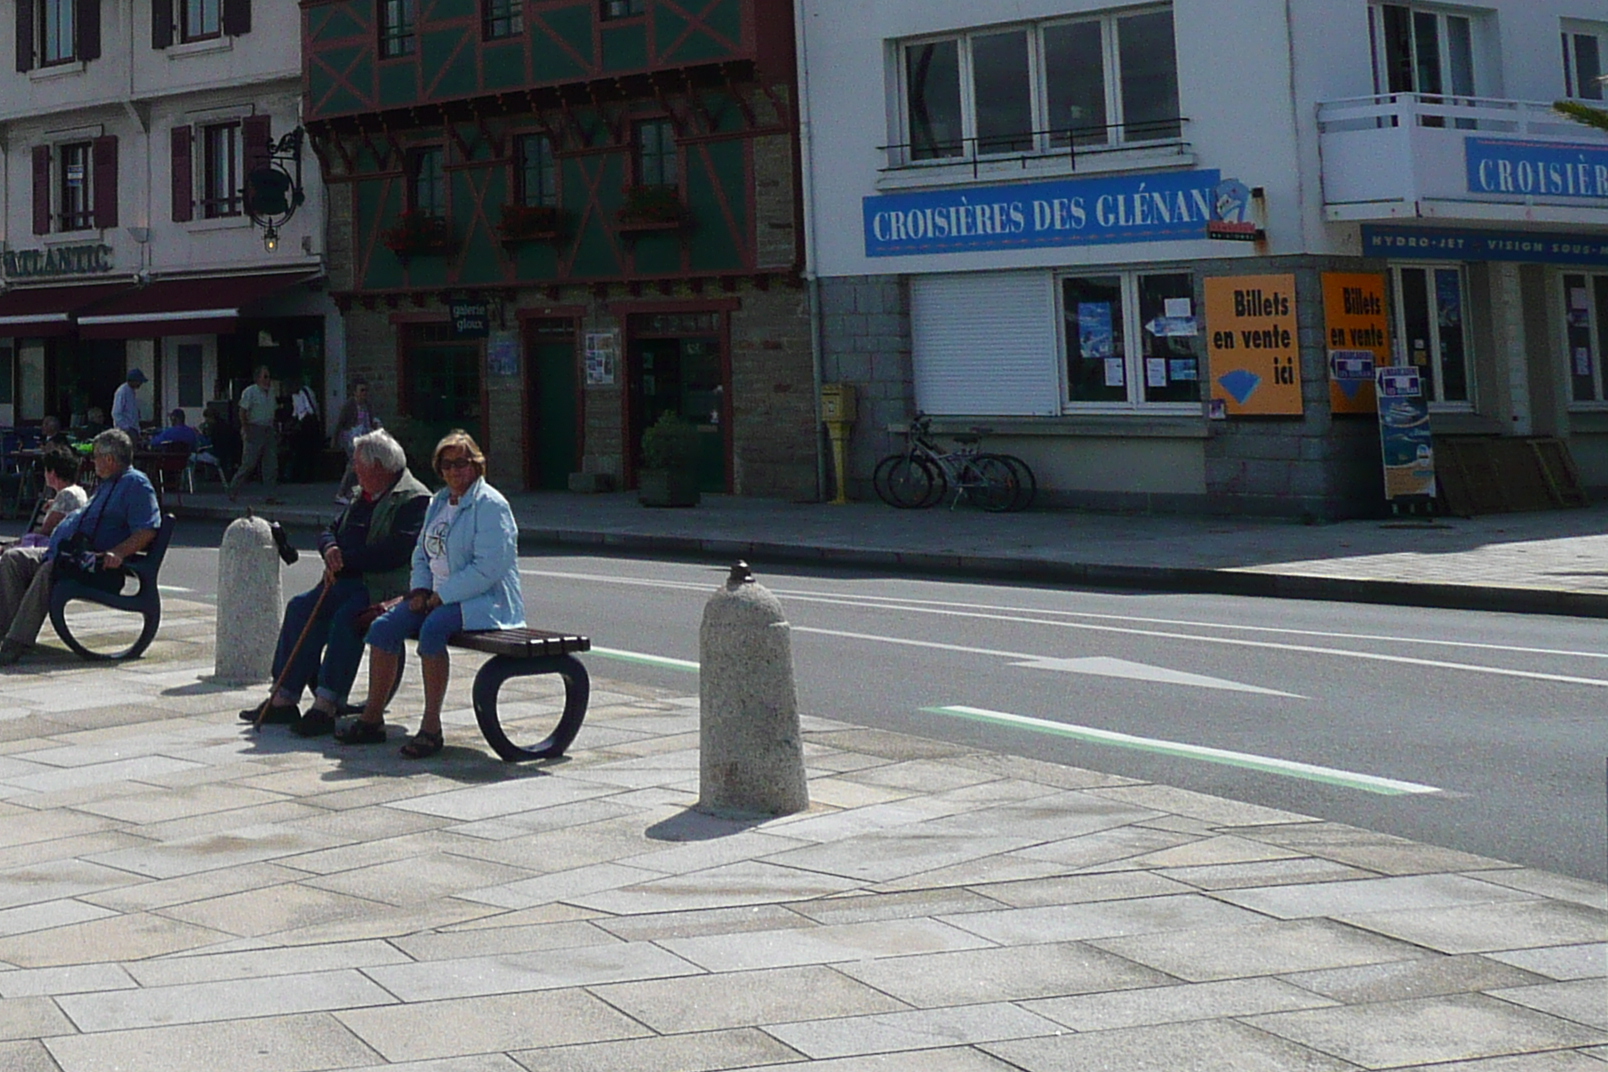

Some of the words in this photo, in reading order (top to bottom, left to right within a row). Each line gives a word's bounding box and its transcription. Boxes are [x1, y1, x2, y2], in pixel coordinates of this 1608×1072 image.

[873, 196, 1024, 241] CROISIÈRES
[1033, 196, 1086, 232] DES
[1096, 182, 1210, 228] GLÉNAN
[1488, 239, 1542, 252] VISION
[453, 303, 485, 318] galerie
[1234, 289, 1289, 317] Billets
[1343, 286, 1381, 315] Billets
[1213, 330, 1235, 349] en
[1242, 324, 1291, 349] vente
[1330, 328, 1345, 346] en
[1349, 323, 1384, 347] vente
[1273, 356, 1294, 385] ici
